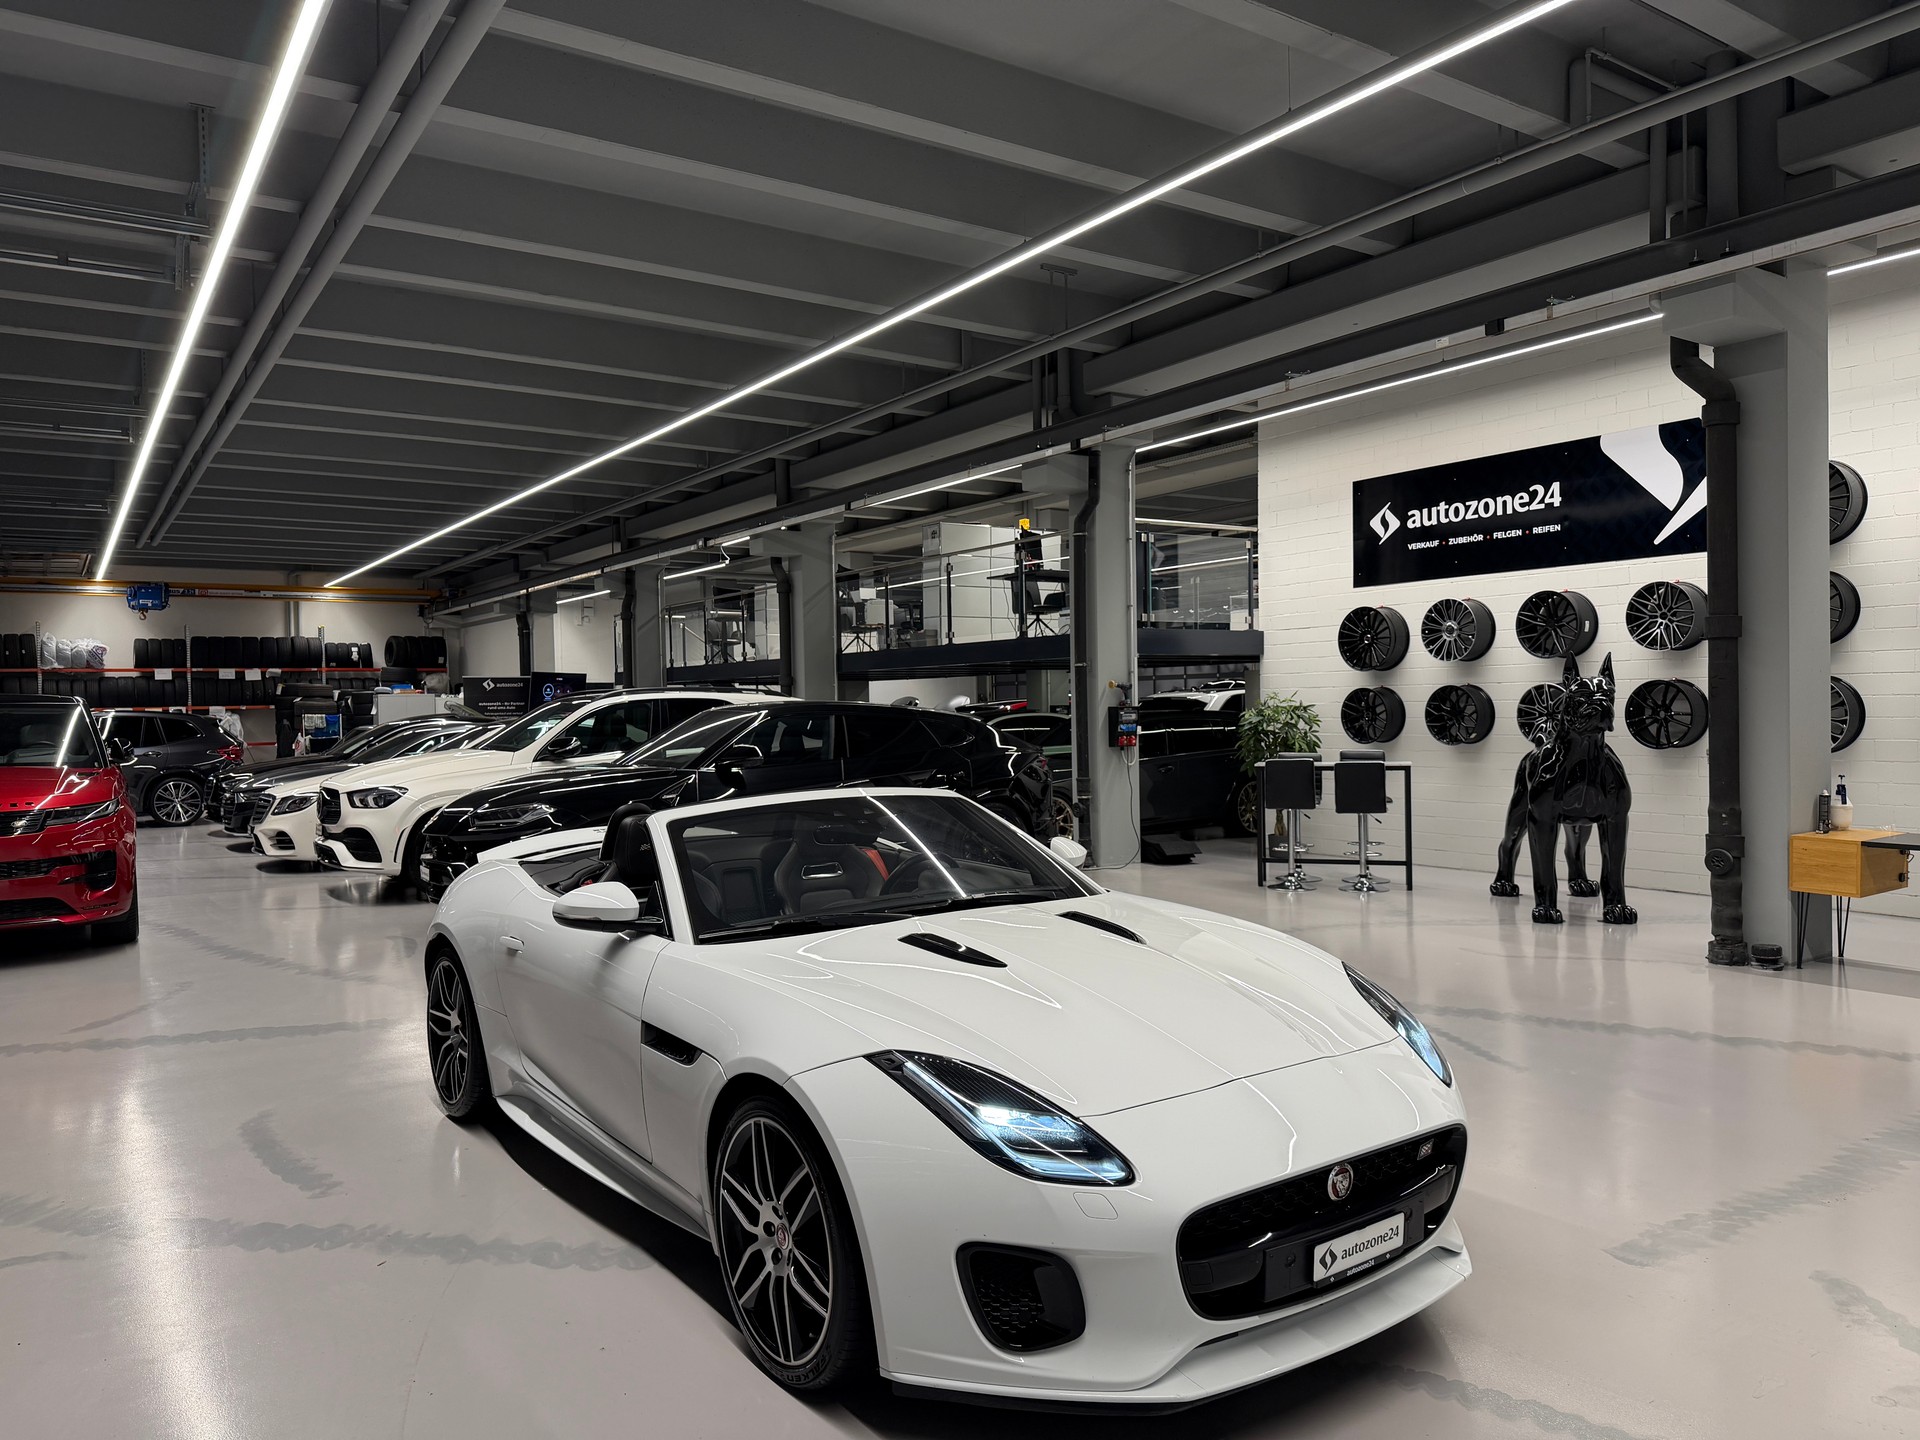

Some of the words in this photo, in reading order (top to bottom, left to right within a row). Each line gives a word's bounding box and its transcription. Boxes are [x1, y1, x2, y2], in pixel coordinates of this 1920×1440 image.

[1406, 481, 1562, 529] autozone24
[1407, 540, 1440, 550] VERKAUF
[1448, 533, 1484, 545] ZUBEHÖR
[1493, 529, 1522, 540] FELGEN
[1532, 524, 1561, 535] REIFEN
[1341, 1225, 1400, 1260] autozone24
[1346, 1259, 1375, 1276] autozone24
